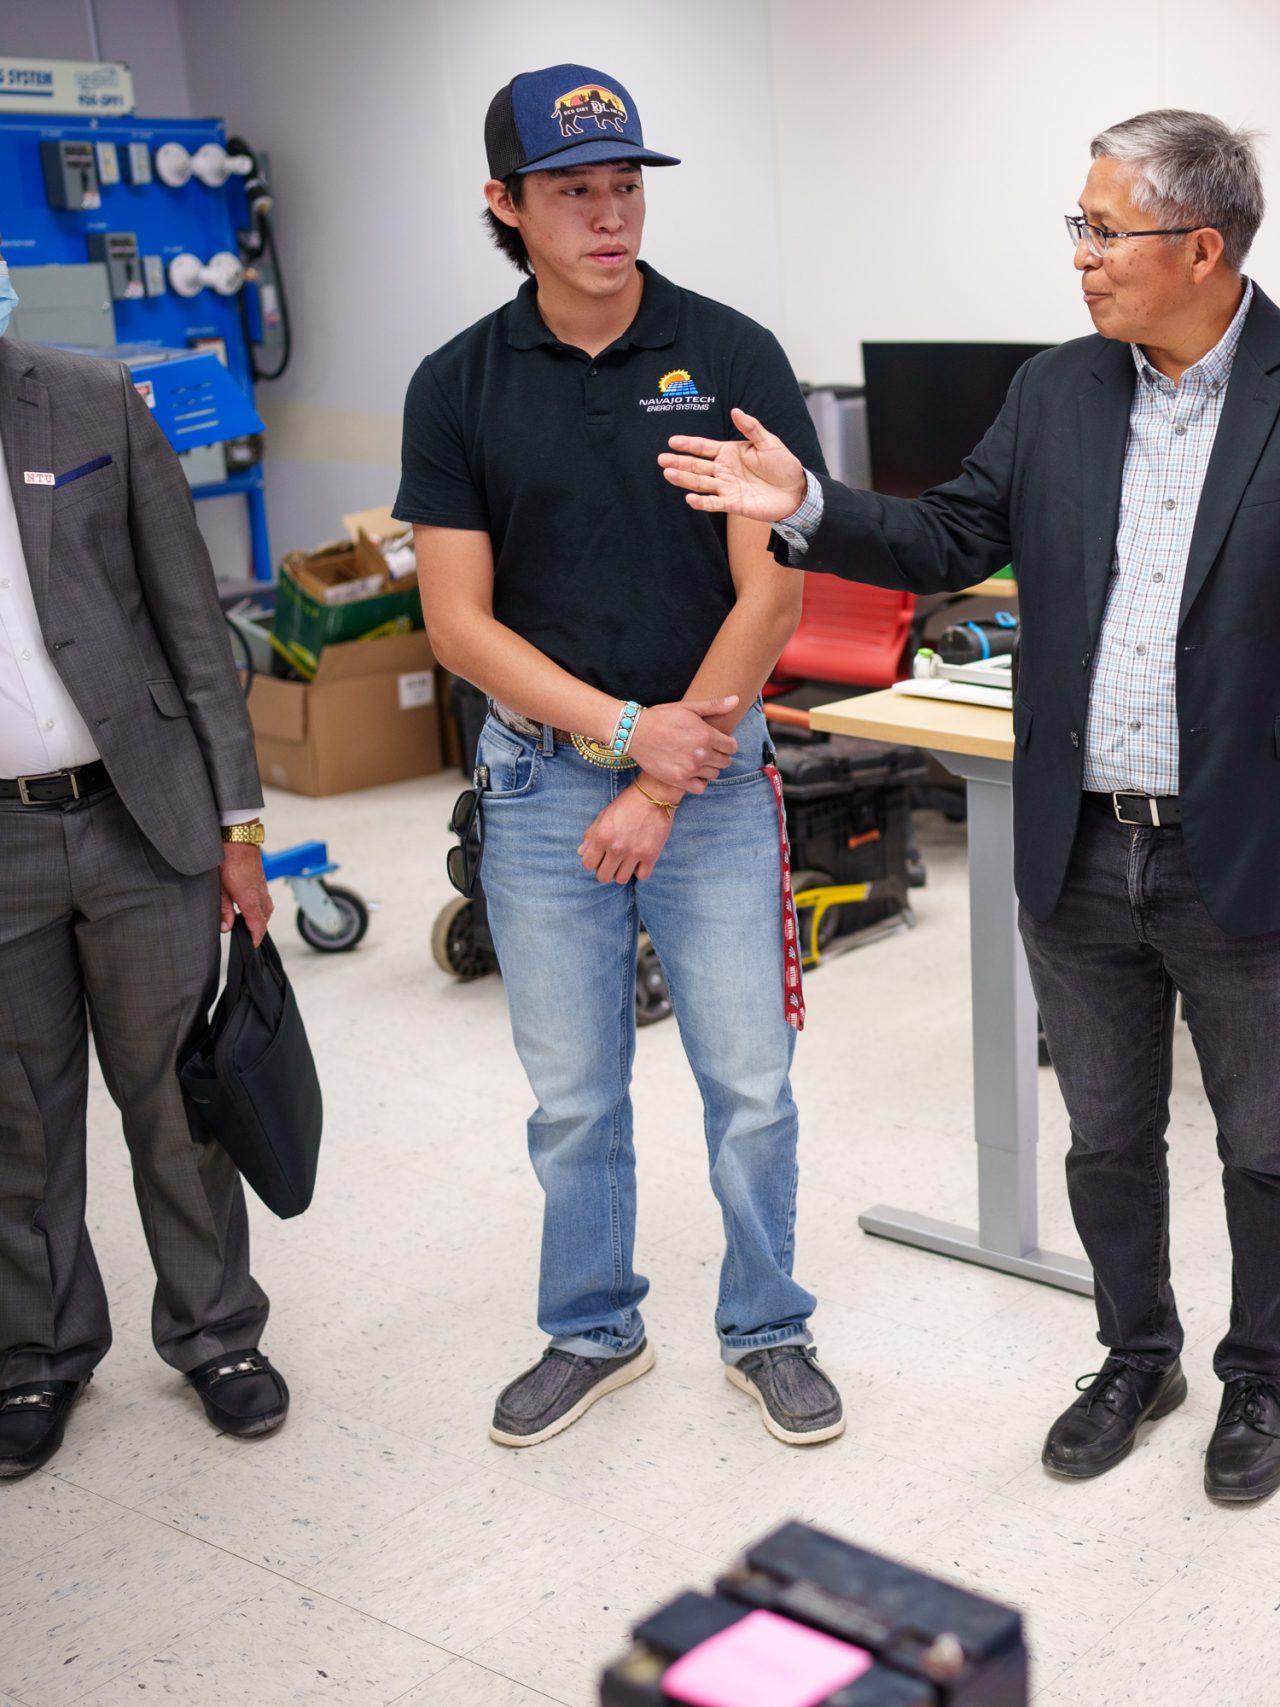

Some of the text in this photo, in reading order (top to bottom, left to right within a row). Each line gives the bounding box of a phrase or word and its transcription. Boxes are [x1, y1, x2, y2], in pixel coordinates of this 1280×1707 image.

[639, 396, 682, 405] NAVAJO
[646, 403, 709, 412] ENERGY SYSTEMS
[26, 473, 53, 483] NTU
[580, 745, 606, 763] ROOKIE
